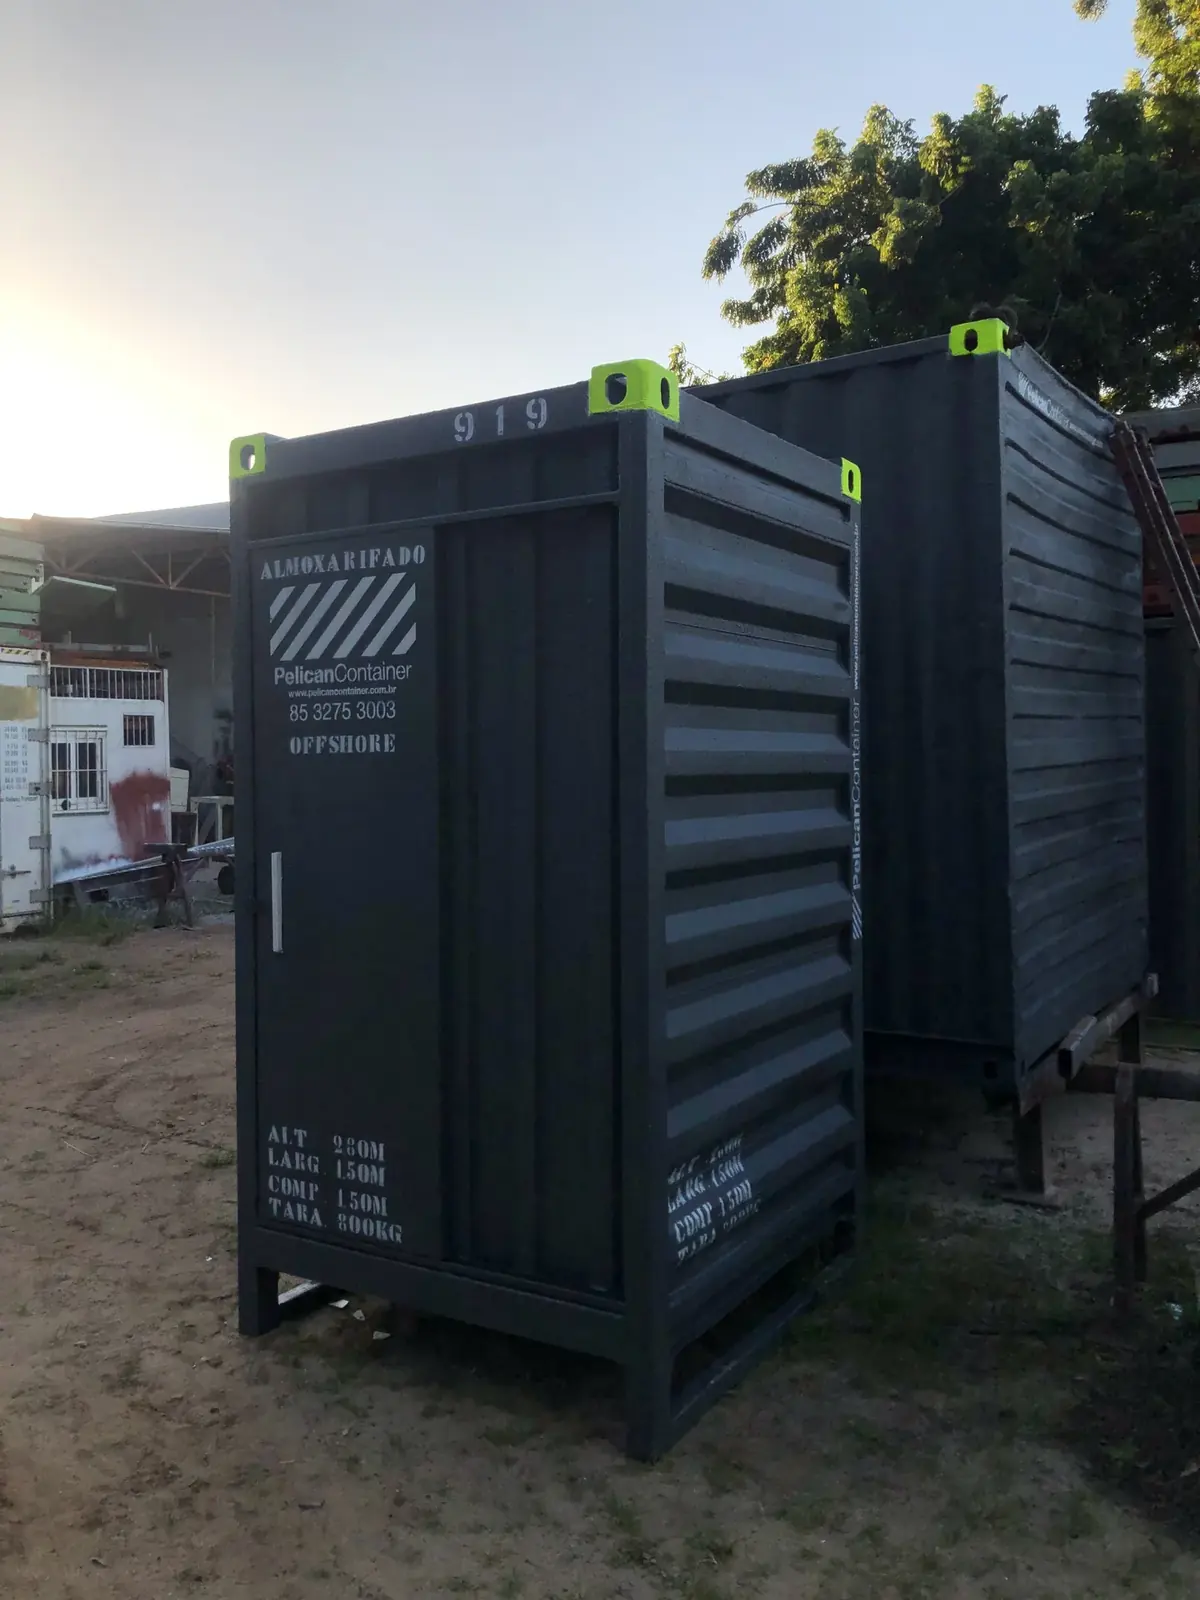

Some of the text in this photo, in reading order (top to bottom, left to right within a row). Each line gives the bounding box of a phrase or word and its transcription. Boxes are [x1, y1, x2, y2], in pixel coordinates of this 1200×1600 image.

[260, 545, 425, 580] ALMOXARIFADO
[274, 661, 412, 685] PelicanContainer
[288, 685, 397, 698] www.pelicancontainer.com.br
[290, 701, 396, 721] 85 3275 3003
[290, 734, 396, 755] OFFSHORE
[268, 1125, 307, 1148] ALT
[338, 1213, 403, 1244] 800KG
